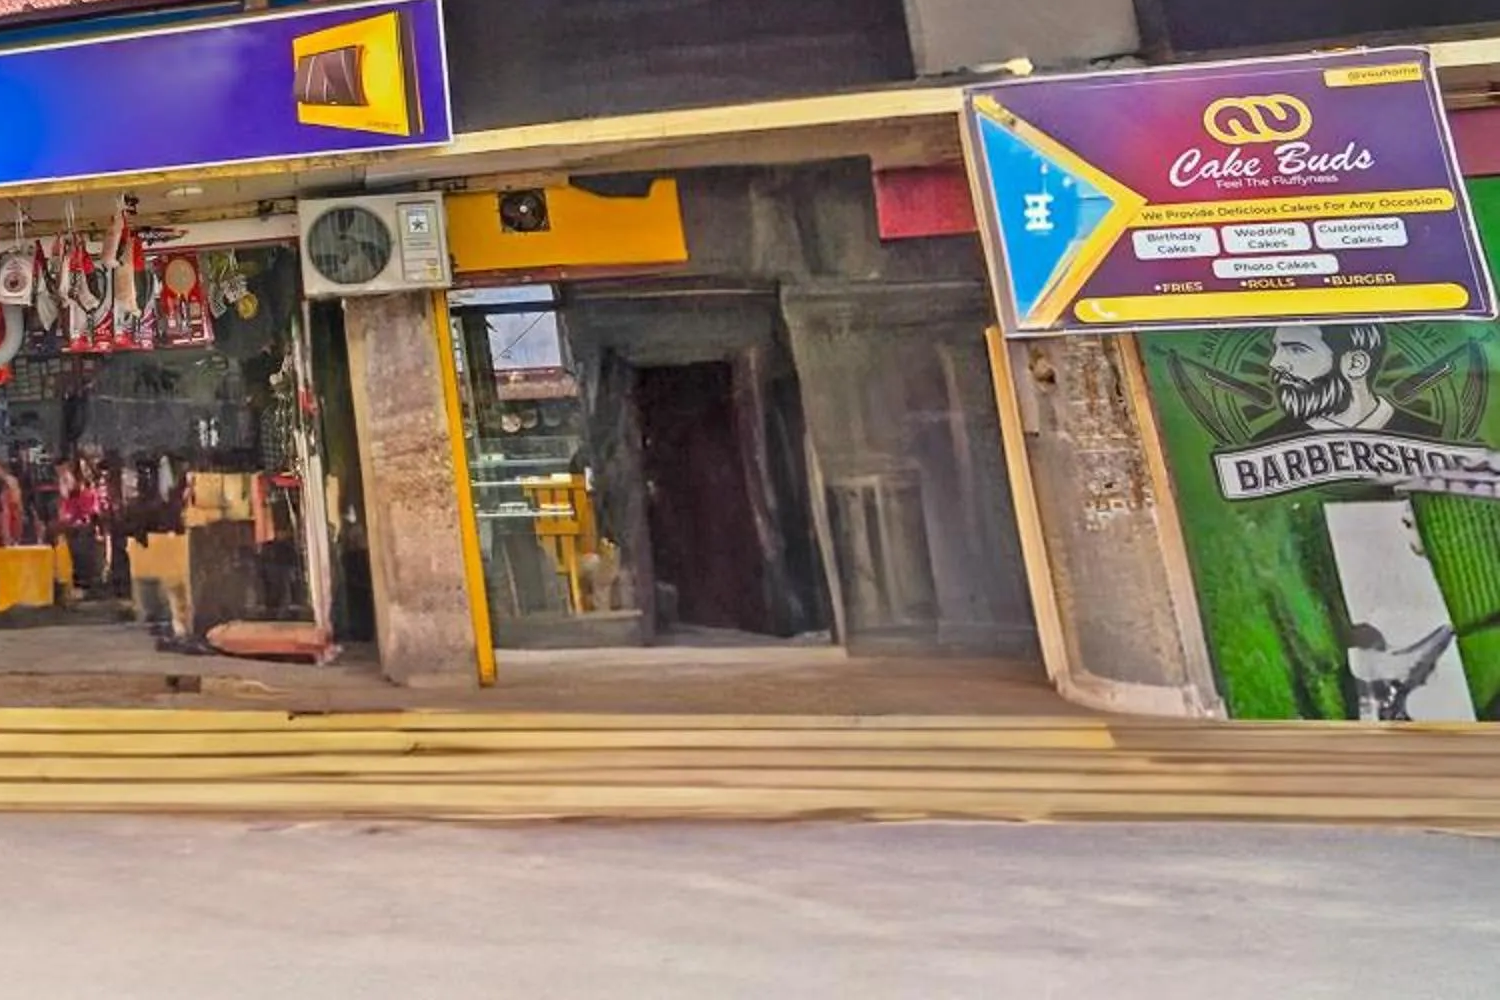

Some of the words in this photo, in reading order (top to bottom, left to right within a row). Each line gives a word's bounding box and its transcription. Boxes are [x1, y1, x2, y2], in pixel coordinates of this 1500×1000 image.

[1169, 148, 1261, 187] Cake
[1274, 141, 1376, 175] Buds
[1216, 178, 1243, 190] Feel
[1245, 176, 1270, 187] The
[1141, 211, 1163, 220] We
[1217, 206, 1278, 217] Delicious
[1281, 202, 1321, 213] Cakes
[1323, 200, 1347, 211] For
[1349, 198, 1376, 211] Any
[1378, 195, 1444, 208] Occasion
[1234, 226, 1296, 239] Wedding
[1317, 221, 1400, 234] Customised
[1147, 231, 1202, 245] Birthday
[1248, 238, 1288, 249] Cakes
[1341, 233, 1383, 245] Cakes
[1157, 244, 1196, 254] Cakes
[1233, 261, 1274, 273] Photo
[1277, 259, 1317, 271] Cakes
